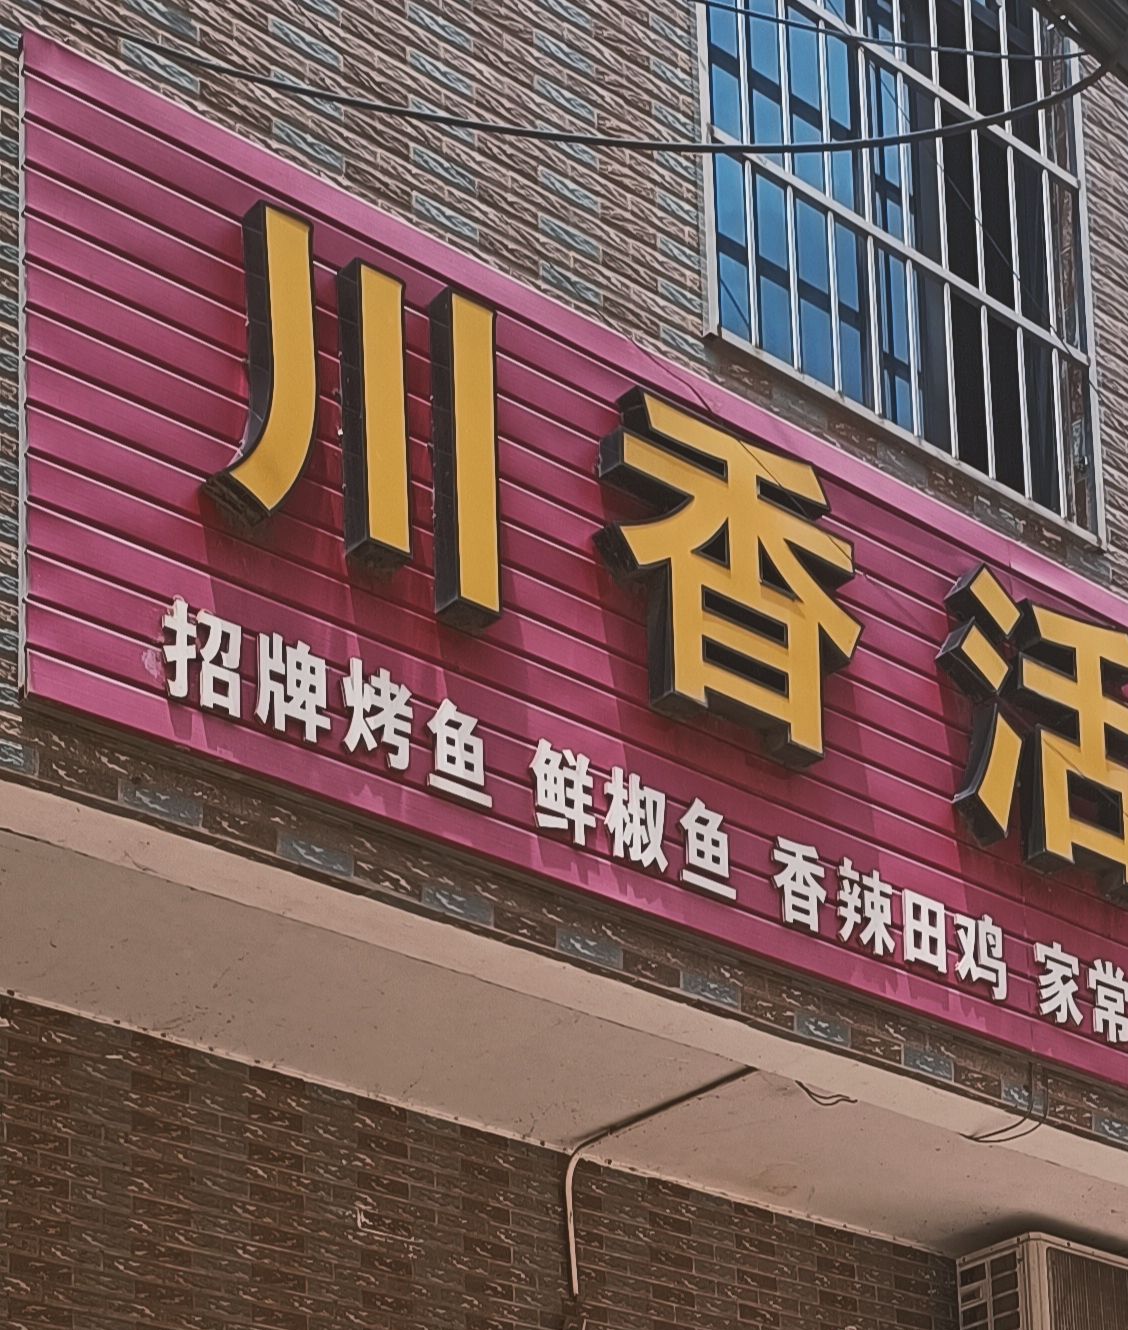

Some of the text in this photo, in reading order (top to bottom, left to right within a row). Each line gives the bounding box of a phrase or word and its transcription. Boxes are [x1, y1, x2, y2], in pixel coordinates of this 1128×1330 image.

[162, 597, 493, 808] 招牌烤鱼
[530, 736, 737, 899] 鲜椒鱼
[772, 836, 1008, 1000] 香辣田鸡
